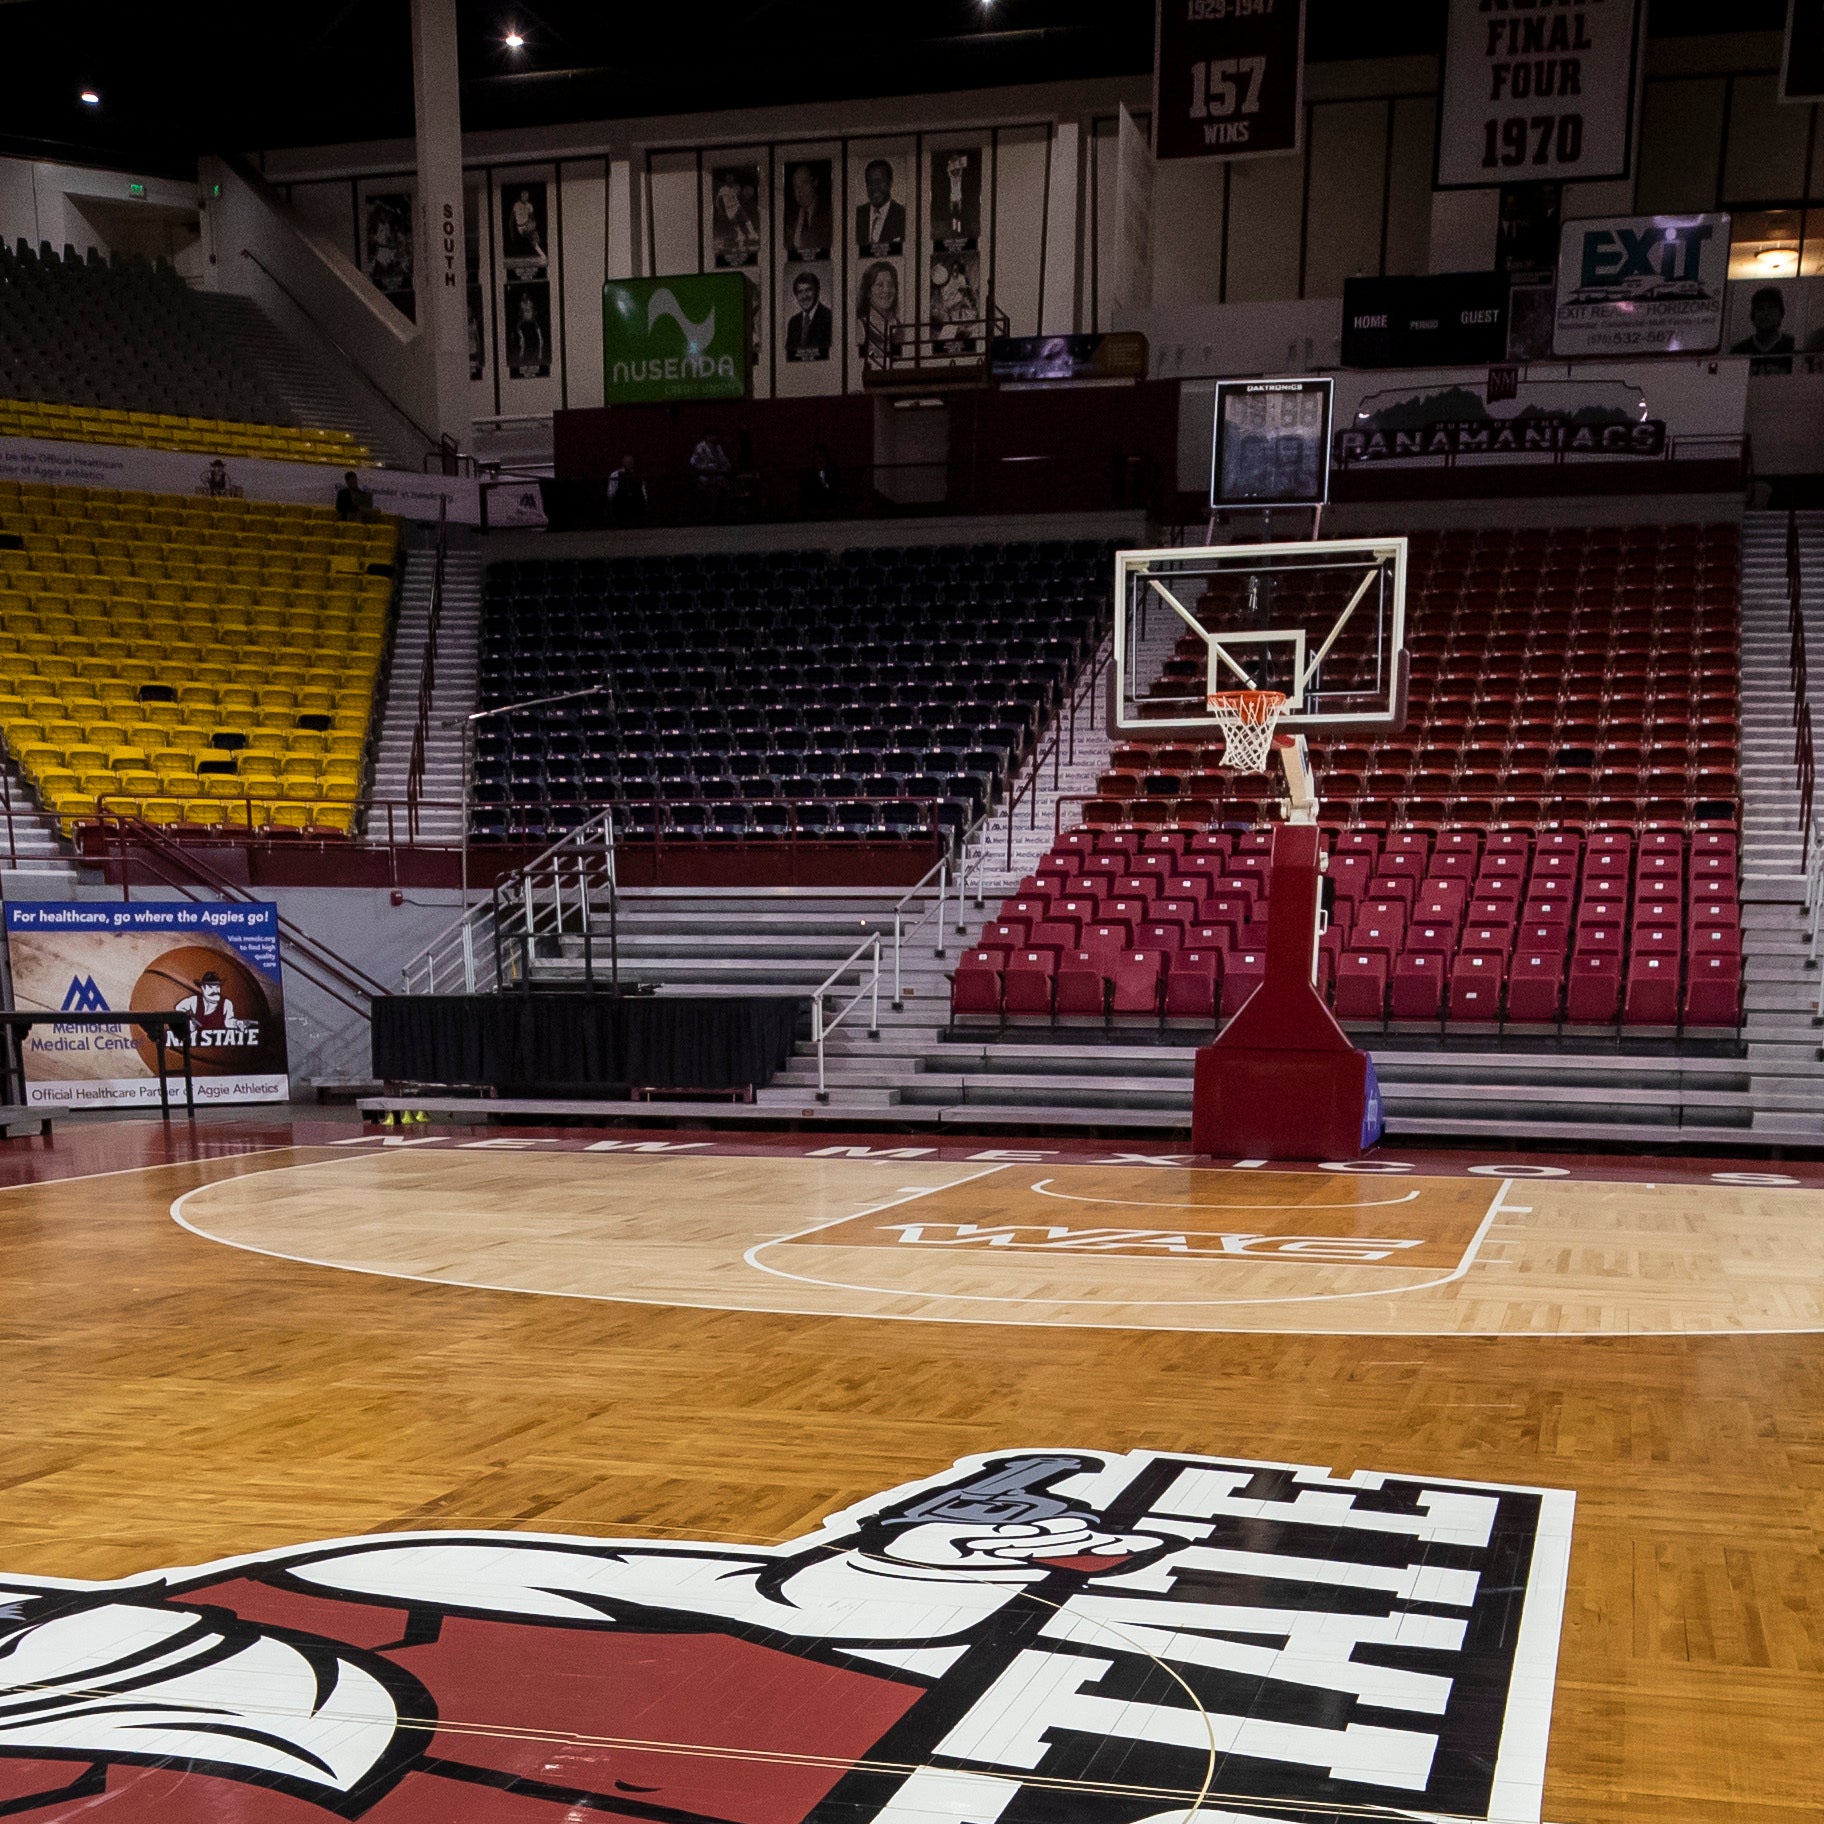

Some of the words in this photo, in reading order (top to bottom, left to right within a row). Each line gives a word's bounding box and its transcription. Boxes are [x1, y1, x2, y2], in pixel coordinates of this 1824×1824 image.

[1486, 14, 1591, 55] FINAL
[1189, 56, 1266, 119] 157
[1490, 59, 1581, 100] FOUR
[1204, 120, 1249, 145] WINS
[1483, 114, 1583, 168] 1970
[443, 204, 456, 287] SOUTH
[1580, 225, 1713, 288] EXIT
[1460, 309, 1500, 324] GUEST
[1557, 306, 1586, 318] EXIT
[1646, 301, 1719, 315] HORIZONS
[1353, 314, 1388, 329] HOME
[1247, 384, 1303, 392] DAKTRONICS
[1340, 424, 1655, 456] PANAMANIACS
[74, 456, 123, 469] Healthcare
[13, 910, 36, 922] For
[39, 910, 109, 924] healthcare,
[114, 912, 130, 925] go
[134, 910, 173, 922] where
[177, 910, 197, 922] the
[201, 911, 244, 925] Aggies
[247, 911, 268, 925] go!
[255, 953, 276, 961] quality
[262, 944, 276, 953] high
[31, 1037, 90, 1051] Medical
[201, 1029, 258, 1047] STATE
[32, 1088, 72, 1100] Official
[76, 1087, 136, 1099] Healthcare
[140, 1086, 179, 1097] Parter
[198, 1084, 229, 1096] Aggie
[233, 1083, 279, 1095] Athletics
[328, 1134, 716, 1152] NEW
[804, 1145, 1570, 1177] MEXICO
[876, 1222, 1426, 1260] WAC
